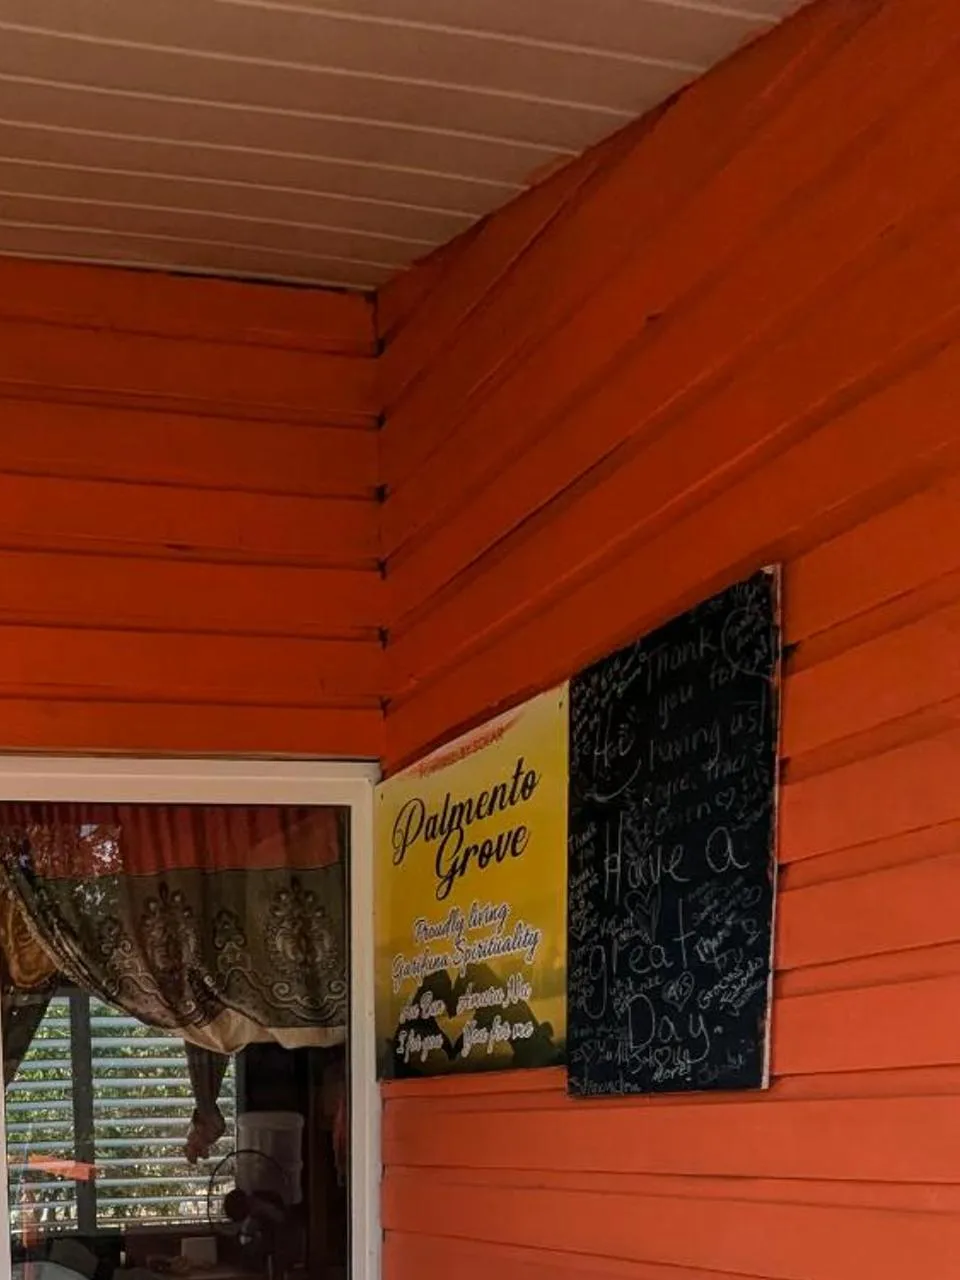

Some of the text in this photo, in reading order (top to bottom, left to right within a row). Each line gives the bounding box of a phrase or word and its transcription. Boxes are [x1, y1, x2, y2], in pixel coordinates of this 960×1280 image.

[658, 683, 694, 730] you
[391, 755, 543, 867] Palmento
[435, 825, 531, 901] Grove
[604, 811, 692, 906] Have
[414, 899, 512, 944] Proudly living
[453, 920, 542, 978] Spirituality
[583, 897, 697, 1019] great
